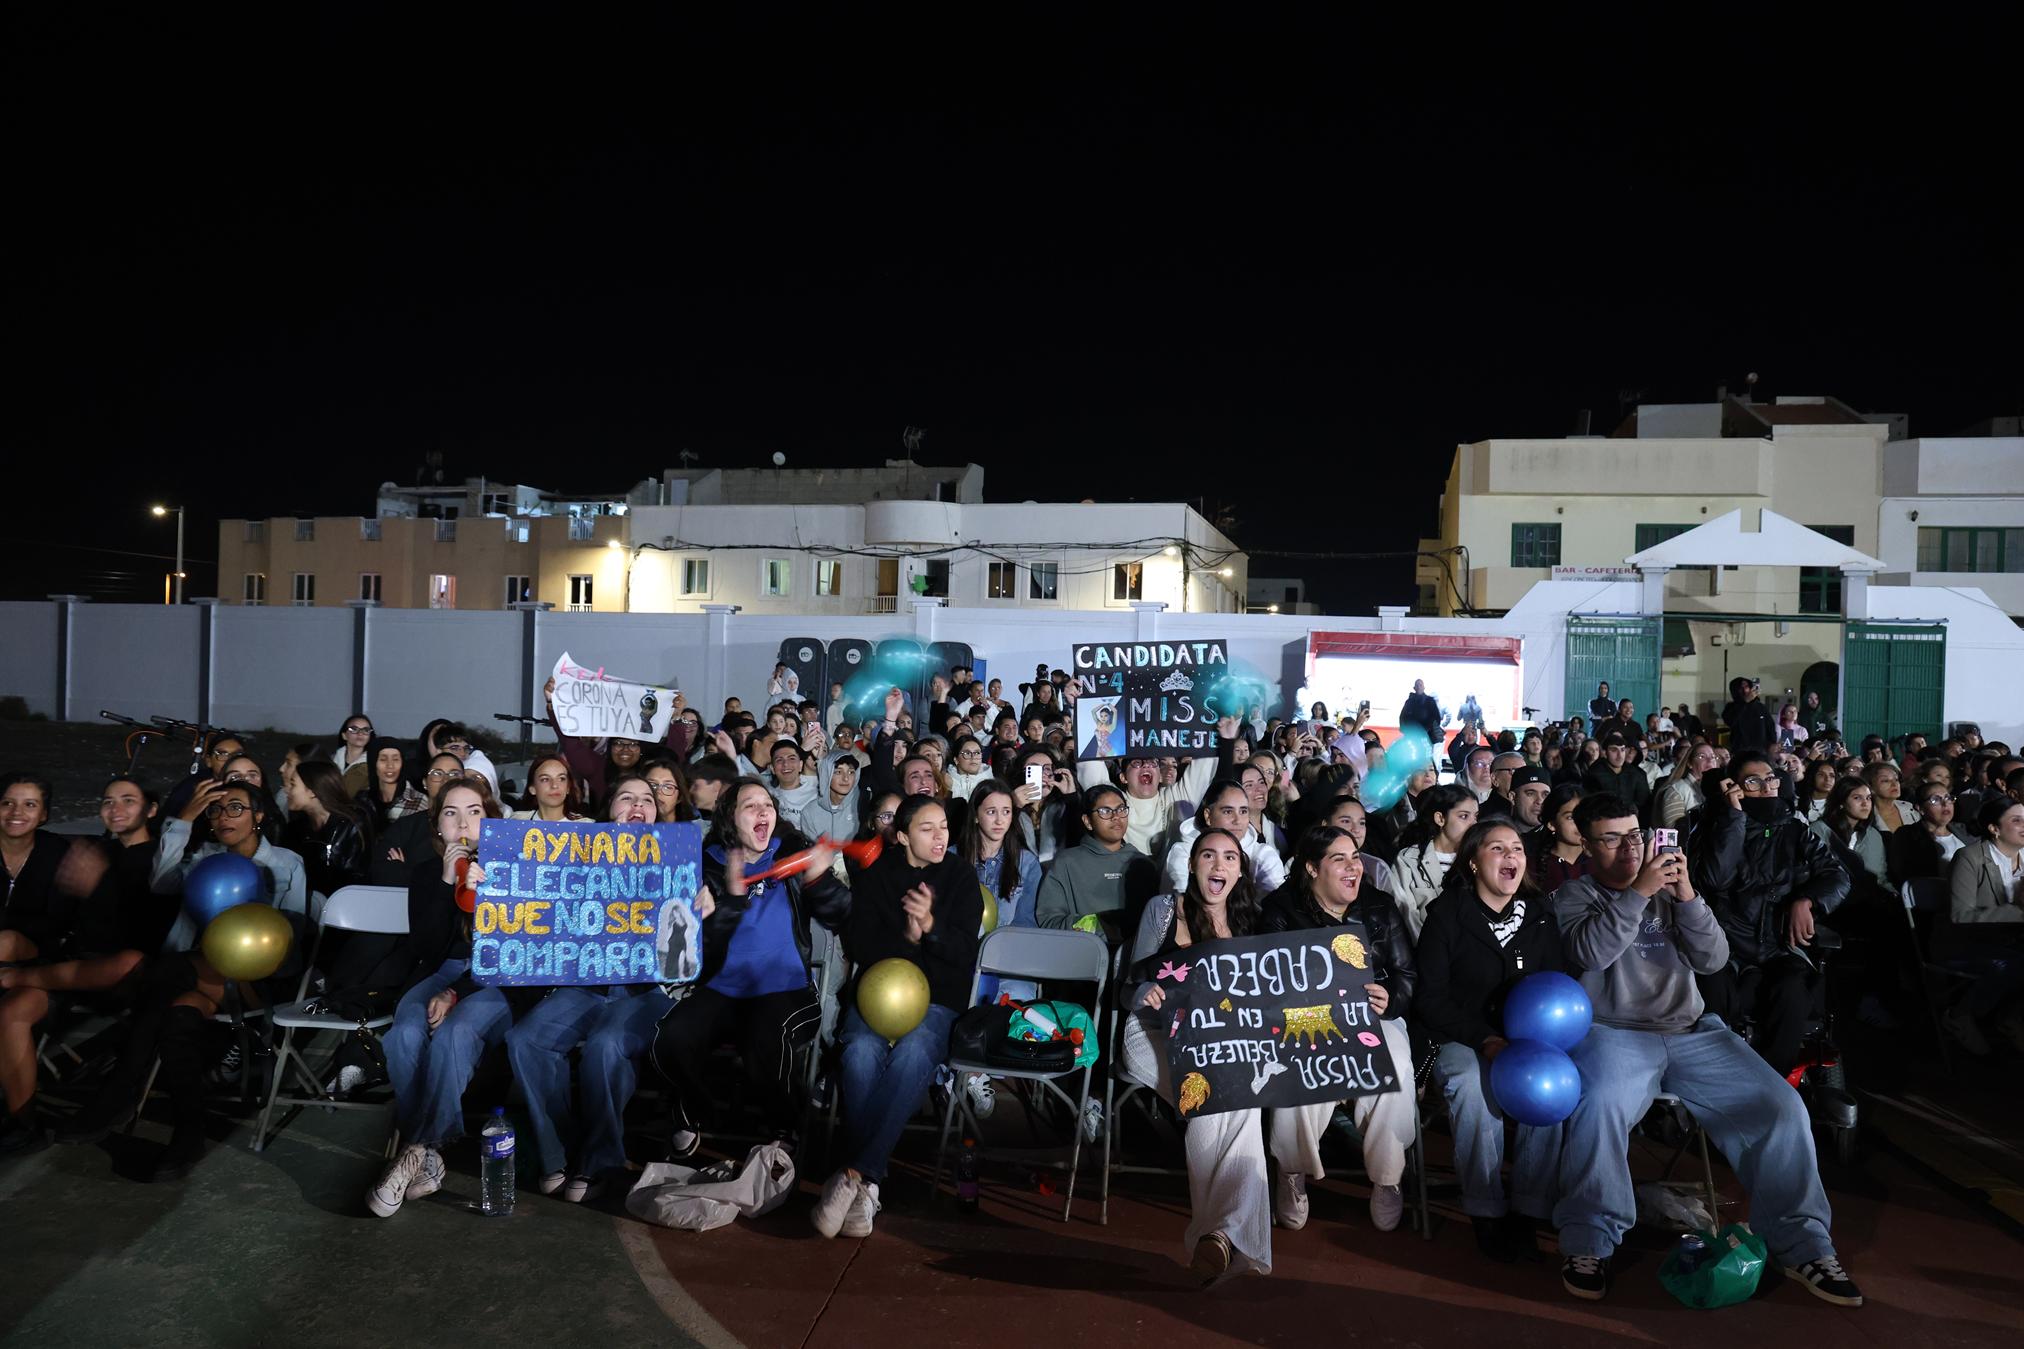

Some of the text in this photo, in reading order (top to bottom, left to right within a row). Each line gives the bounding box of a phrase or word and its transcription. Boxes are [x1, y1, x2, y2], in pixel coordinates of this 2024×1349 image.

[1075, 643, 1226, 669] CANDIDATA
[555, 680, 627, 708] CORONA
[556, 703, 636, 735] ES TUYA
[1129, 696, 1219, 725] MISS
[1129, 728, 1218, 748] MANEJE
[522, 827, 661, 865] AYNARA
[478, 860, 698, 900] ELEGANCIA
[554, 900, 605, 936] NO
[606, 901, 655, 935] SE
[471, 937, 656, 978] COMPARA
[1195, 944, 1334, 997] CABEZA
[1191, 1002, 1371, 1029] LA EN TU
